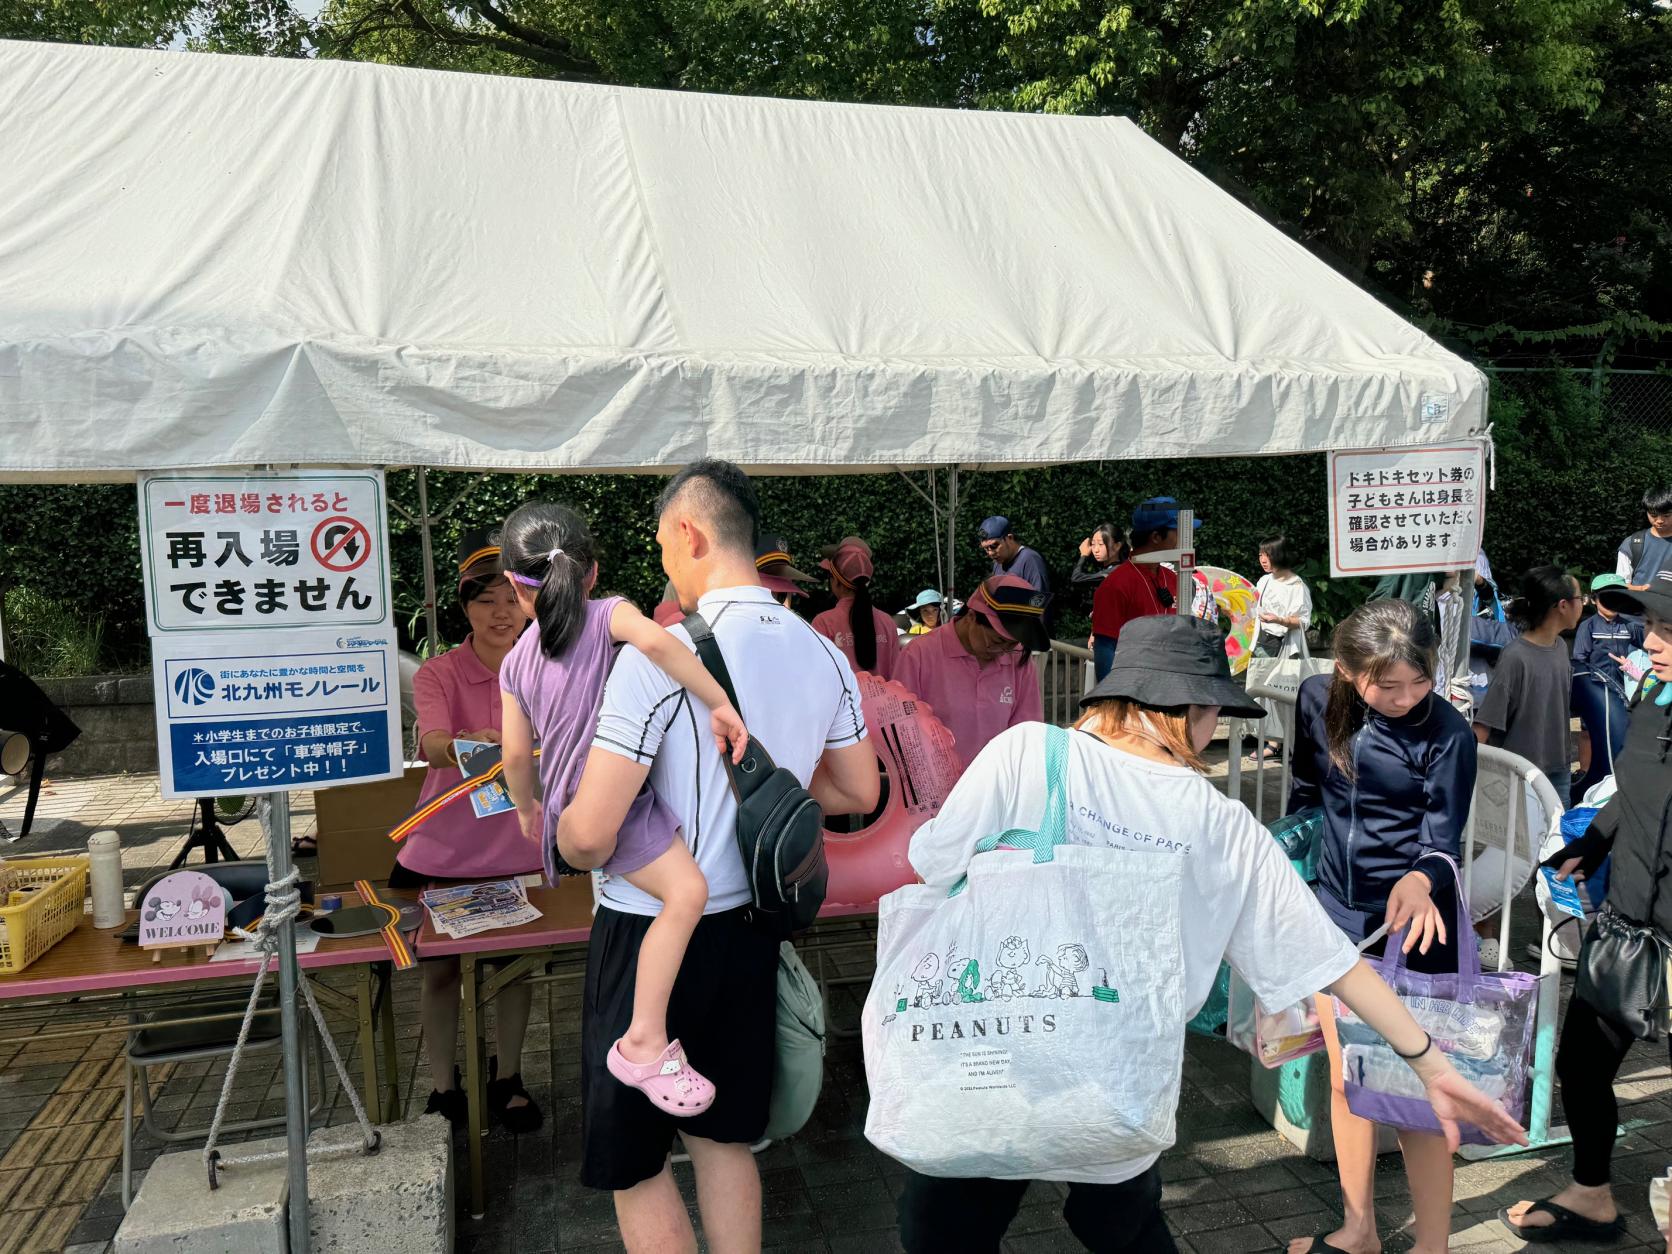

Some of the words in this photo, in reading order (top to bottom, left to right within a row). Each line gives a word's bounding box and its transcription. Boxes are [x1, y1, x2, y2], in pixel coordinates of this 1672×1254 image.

[1349, 467, 1475, 487] ドキドキセット券の
[164, 491, 349, 515] 一度退場されると
[1347, 488, 1475, 509] 子どもさんは身長を
[1348, 511, 1473, 531] 確認させていただく
[165, 529, 300, 569] 再入場
[1349, 532, 1457, 553] 場合があります。
[169, 576, 373, 616] できません
[219, 663, 366, 680] 街にあなたに豊かな時間と空間を
[221, 677, 381, 702] 北九州モノレール
[194, 740, 368, 766] 入場口にて「車掌帽子」
[221, 758, 347, 783] プレゼント中！！
[1079, 806, 1129, 837] CHANGE
[1133, 831, 1152, 844] OF
[145, 922, 220, 939] WELCOME
[911, 1013, 1057, 1042] PEANUTS
